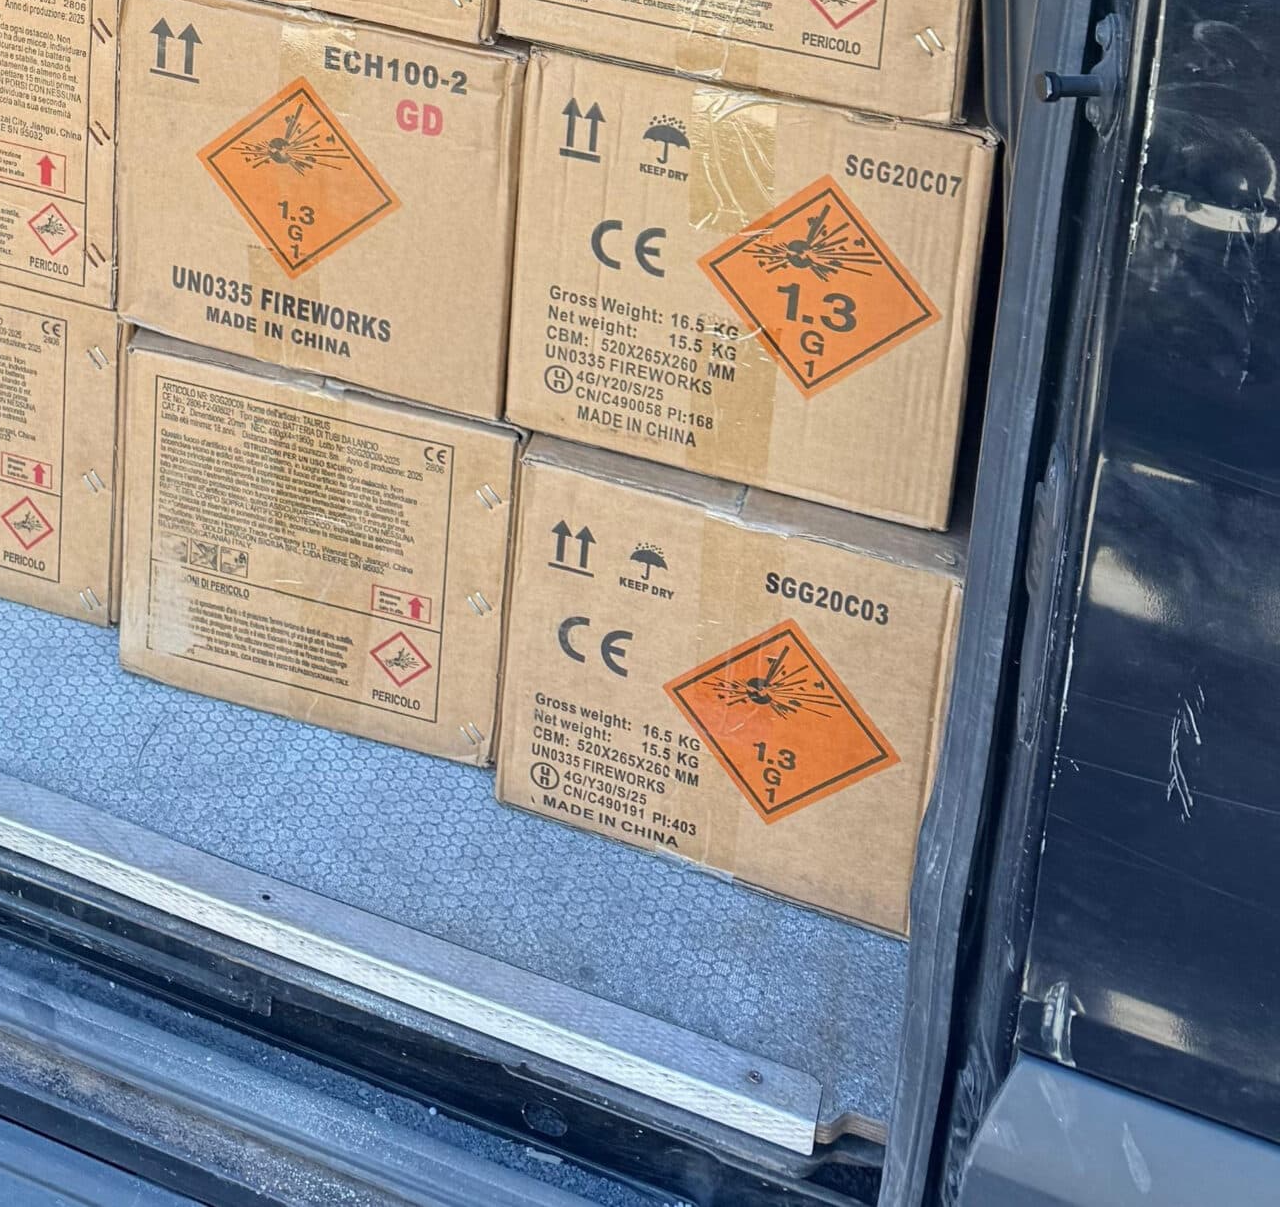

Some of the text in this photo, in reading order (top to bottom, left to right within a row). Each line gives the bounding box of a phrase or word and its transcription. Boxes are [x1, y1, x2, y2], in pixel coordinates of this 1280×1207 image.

[802, 32, 860, 56] PERICOLO
[324, 46, 467, 94] ECH100-2
[396, 99, 443, 136] GD
[640, 163, 688, 181] KEEP DRY
[845, 154, 962, 197] SGG20C07
[278, 201, 314, 225] 1.3
[288, 226, 302, 241] G
[30, 256, 69, 275] PERICOLO
[291, 244, 300, 258] 1
[172, 266, 391, 342] UN0335 FIREWORKS
[549, 285, 739, 342] Gross Weight: 16.5 KG
[777, 283, 856, 332] 1.3
[206, 306, 350, 358] MADE IN CHINA
[548, 305, 736, 361] Net weight: 15.5 KG
[800, 331, 824, 355] G
[546, 325, 735, 382] CBM: 520X265X260 MM
[546, 344, 712, 396] UN0335 FIREWORKS
[804, 361, 814, 378] 1
[576, 371, 664, 402] 4G/Y20/S/25
[576, 386, 713, 430] CN/C490058 PI:168
[577, 405, 696, 447] MADE IN CHINA
[3, 550, 45, 571] PERICOLO
[620, 577, 674, 600] KEEP DRY
[766, 572, 889, 625] SGG20C03
[372, 689, 420, 710] PERICOLO
[753, 741, 796, 770] 1.3
[763, 768, 781, 786] G
[766, 788, 775, 803] 1
[543, 796, 677, 847] MADE IN CHINA
